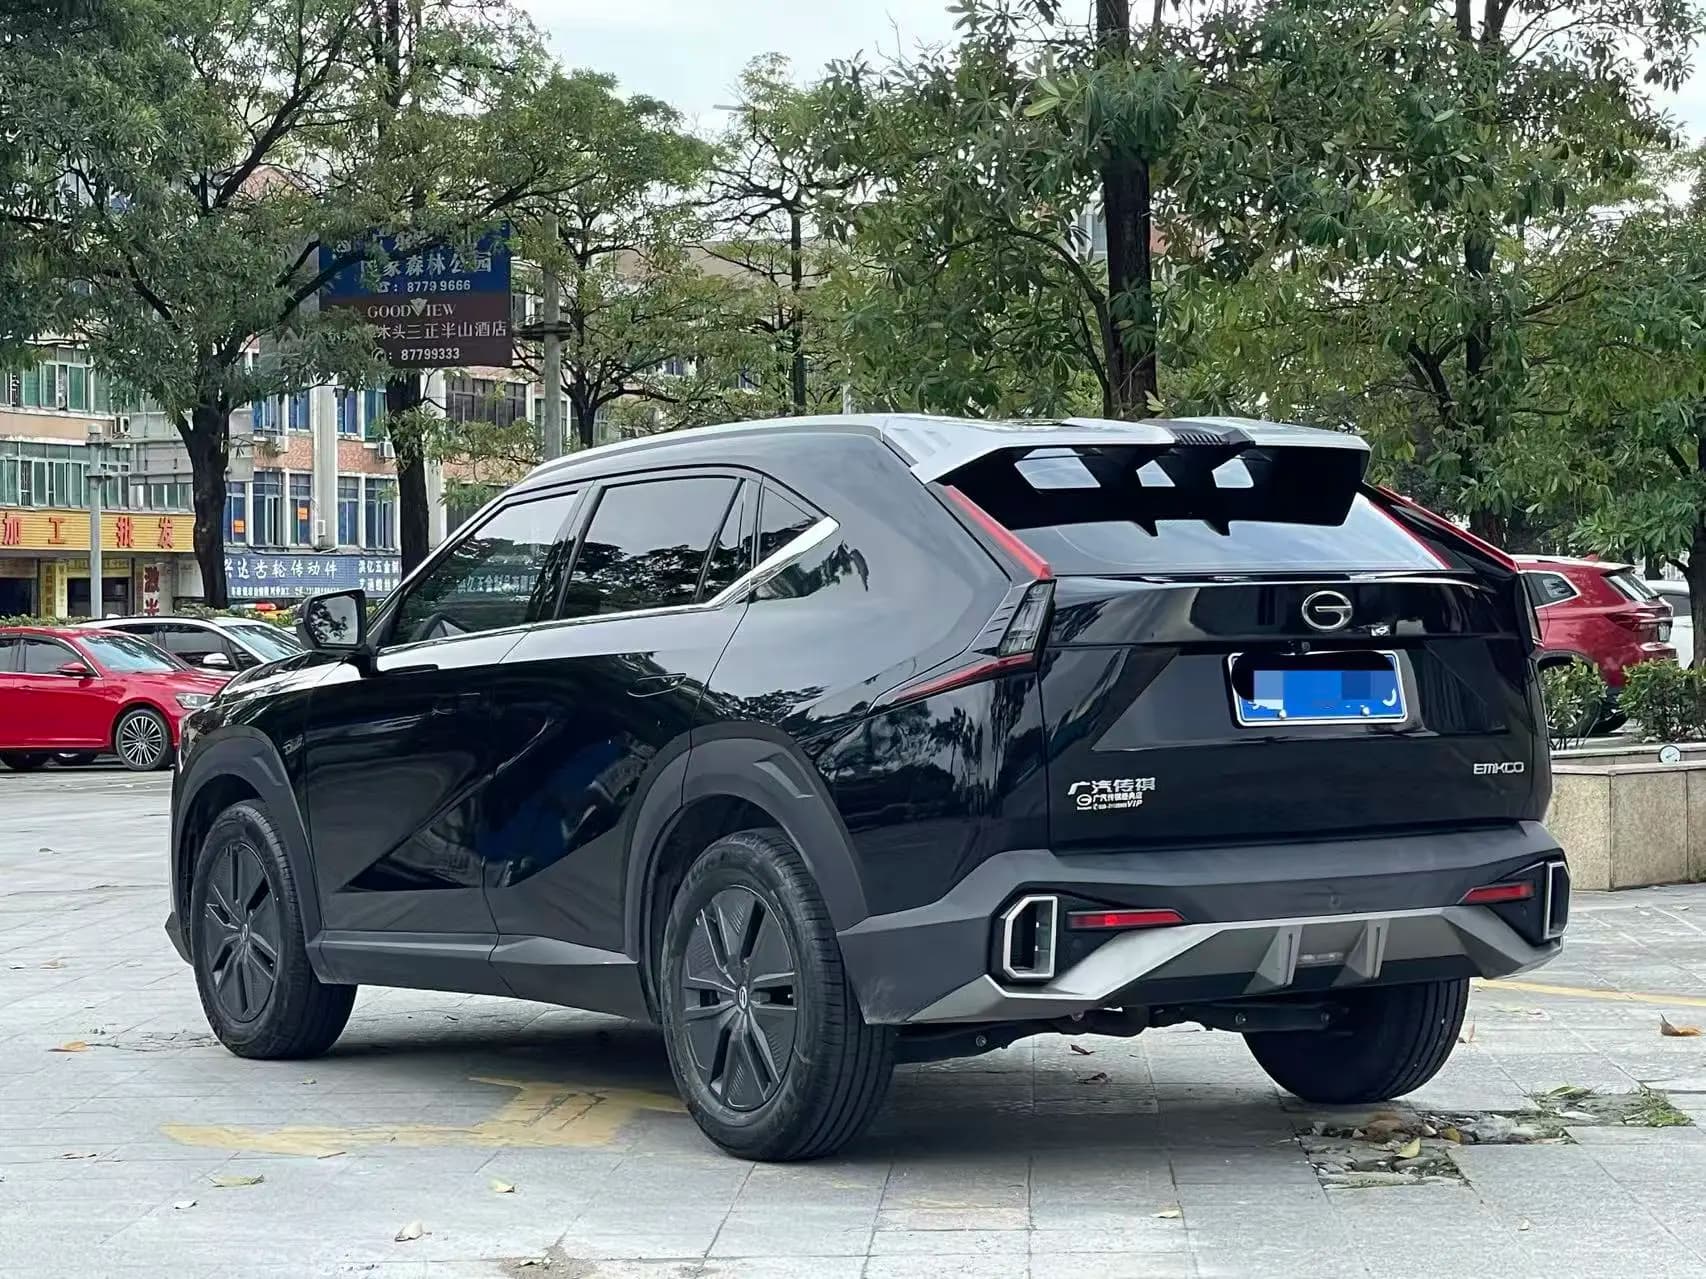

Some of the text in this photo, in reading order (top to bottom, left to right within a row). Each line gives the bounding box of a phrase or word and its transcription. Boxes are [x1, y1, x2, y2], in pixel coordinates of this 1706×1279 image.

[376, 321, 507, 340] 木头三正半山酒店
[401, 348, 460, 361] 87799333
[116, 516, 174, 548] 批发
[1067, 777, 1156, 796] 广汽传祺
